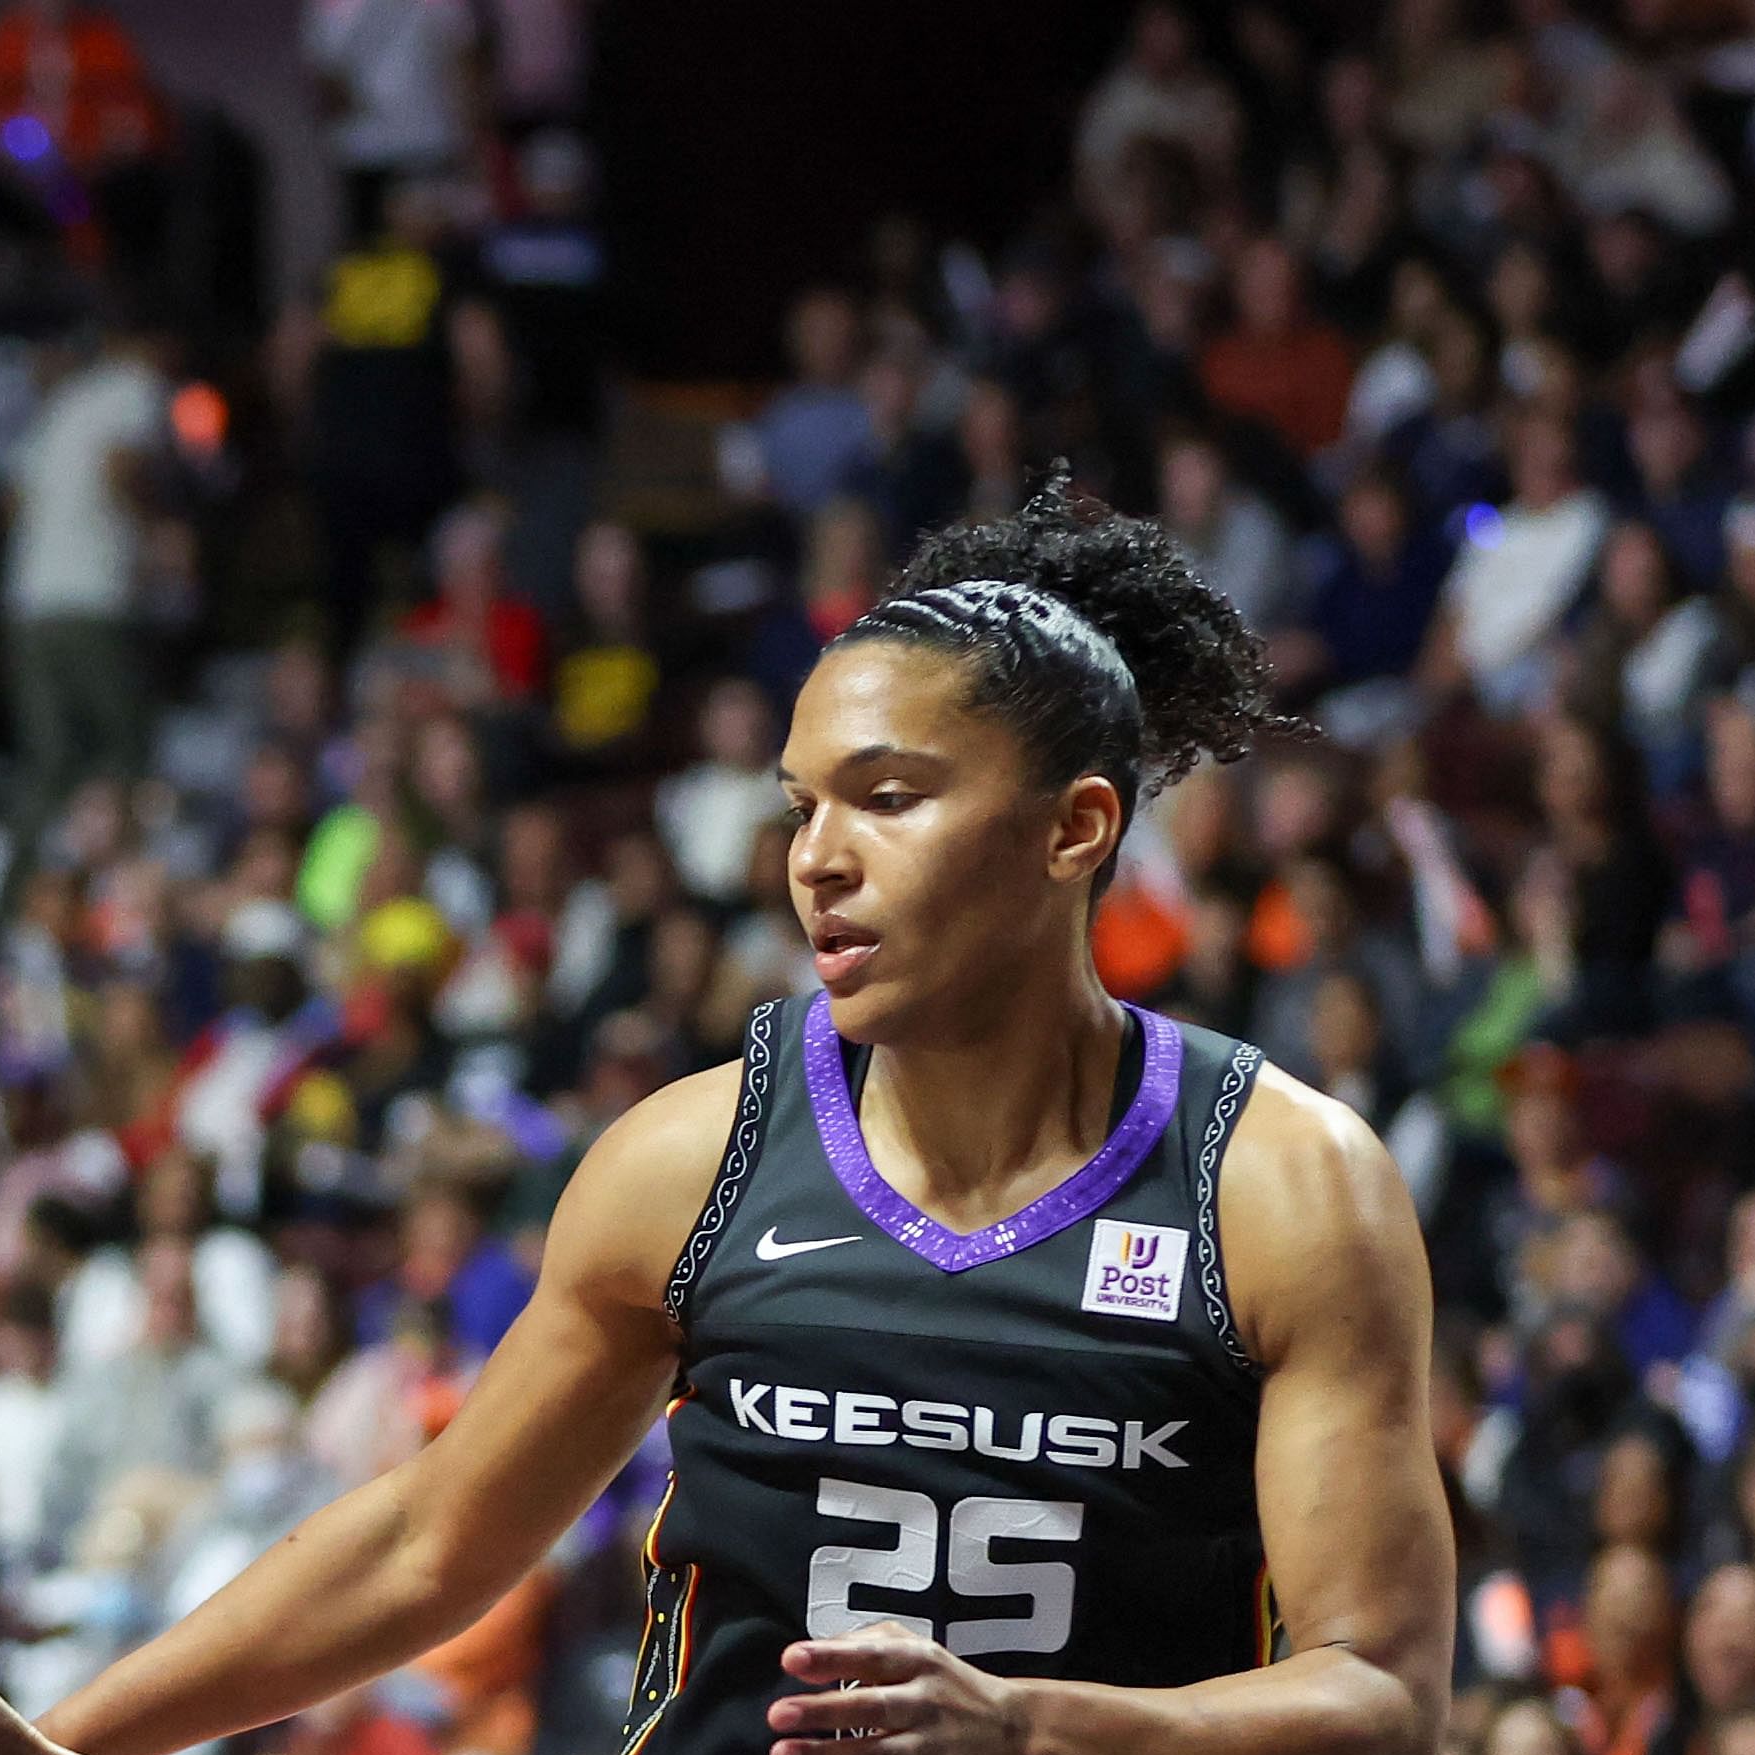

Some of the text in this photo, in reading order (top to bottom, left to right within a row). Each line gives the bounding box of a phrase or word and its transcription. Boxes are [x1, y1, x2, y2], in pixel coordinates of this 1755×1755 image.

[1100, 1265, 1171, 1298] Post
[729, 1378, 1191, 1470] KEESUSK
[806, 1477, 1085, 1656] 25
